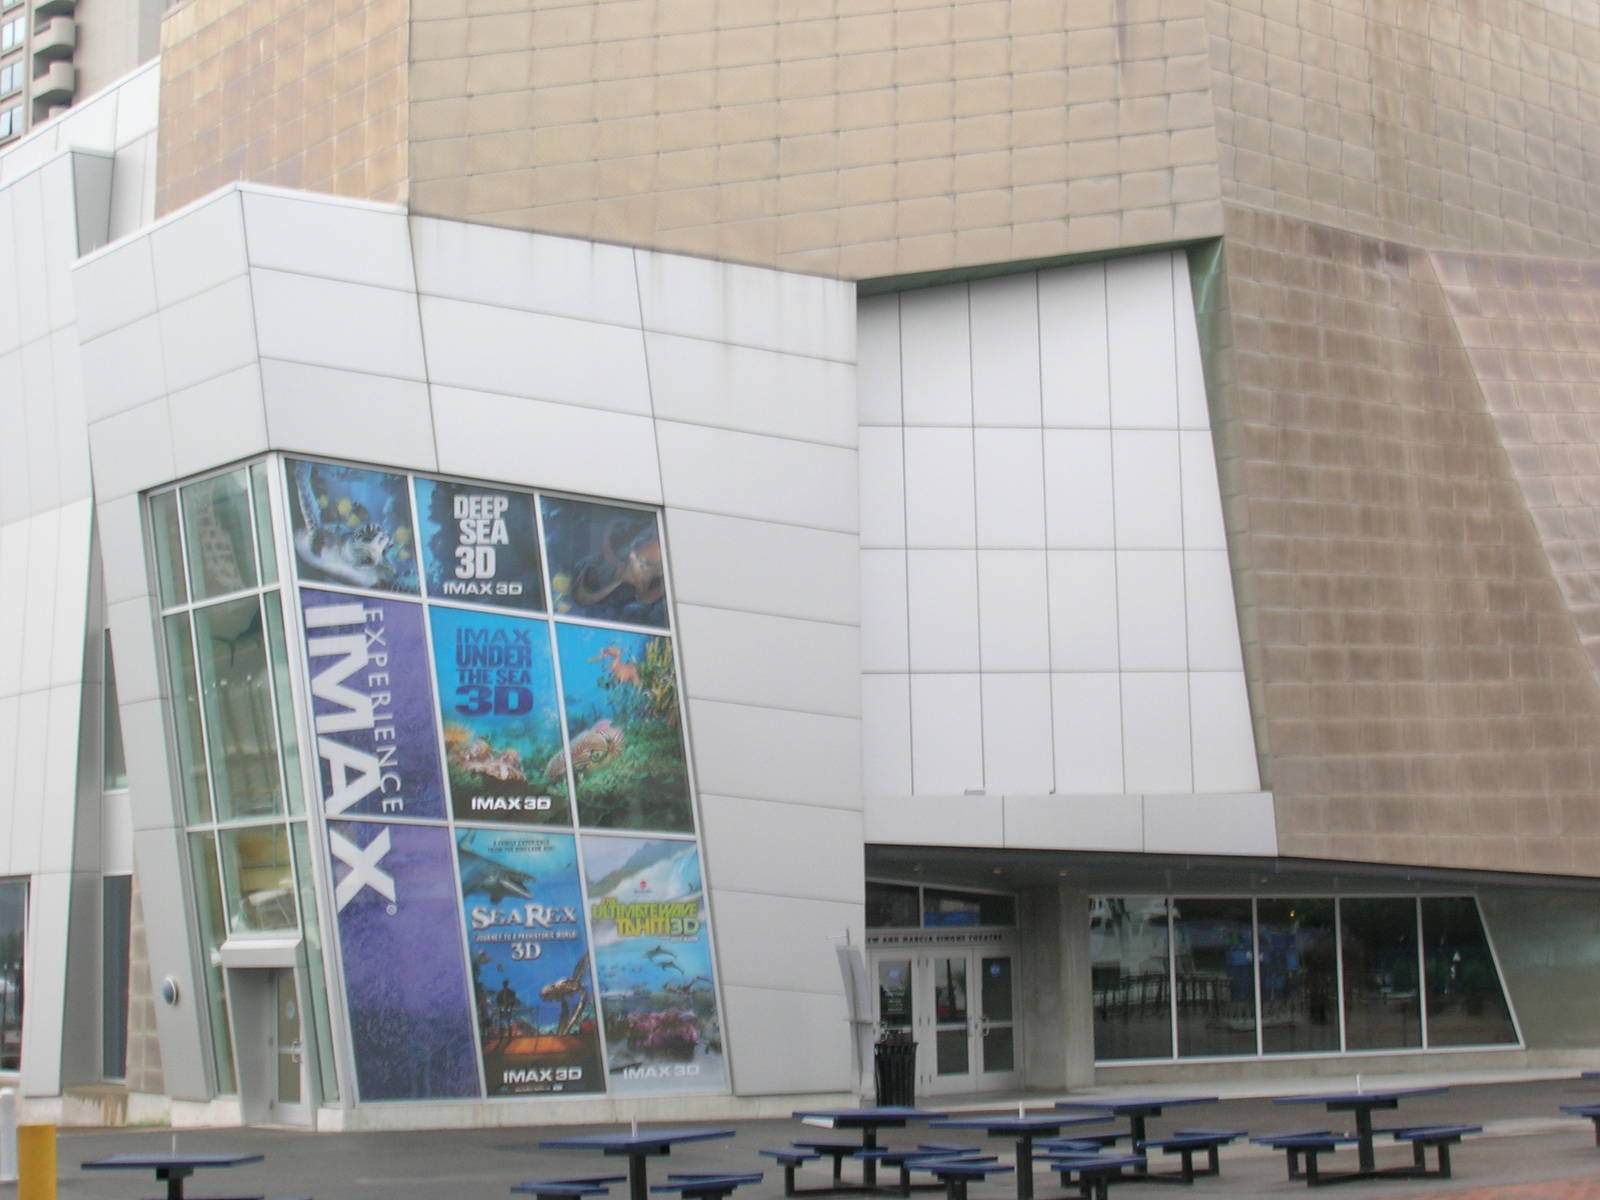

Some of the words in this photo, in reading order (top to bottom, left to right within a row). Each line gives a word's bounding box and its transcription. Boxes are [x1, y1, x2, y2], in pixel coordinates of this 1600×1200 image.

[454, 495, 508, 519] DEEP
[459, 518, 509, 545] SEA
[455, 546, 496, 579] 3D
[443, 582, 493, 595] IMAX
[495, 582, 522, 595] 3D
[456, 628, 531, 646] IMAX
[456, 645, 532, 668] UNDER
[456, 669, 492, 685] THE
[495, 670, 531, 685] SEA
[455, 685, 534, 716] 3D
[363, 607, 403, 813] EXPERIENCE
[304, 603, 396, 913] IMAX
[471, 796, 521, 810] IMAX
[524, 796, 551, 810] 3D
[591, 904, 659, 920] ULTIMATE
[659, 903, 697, 919] WAVE
[616, 917, 671, 936] TAHITI
[671, 918, 699, 936] 3D
[511, 942, 542, 960] 3D
[503, 1068, 551, 1084] IMAX
[555, 1066, 582, 1081] 3D
[623, 1065, 673, 1079] IMAX
[675, 1063, 699, 1076] 3D
